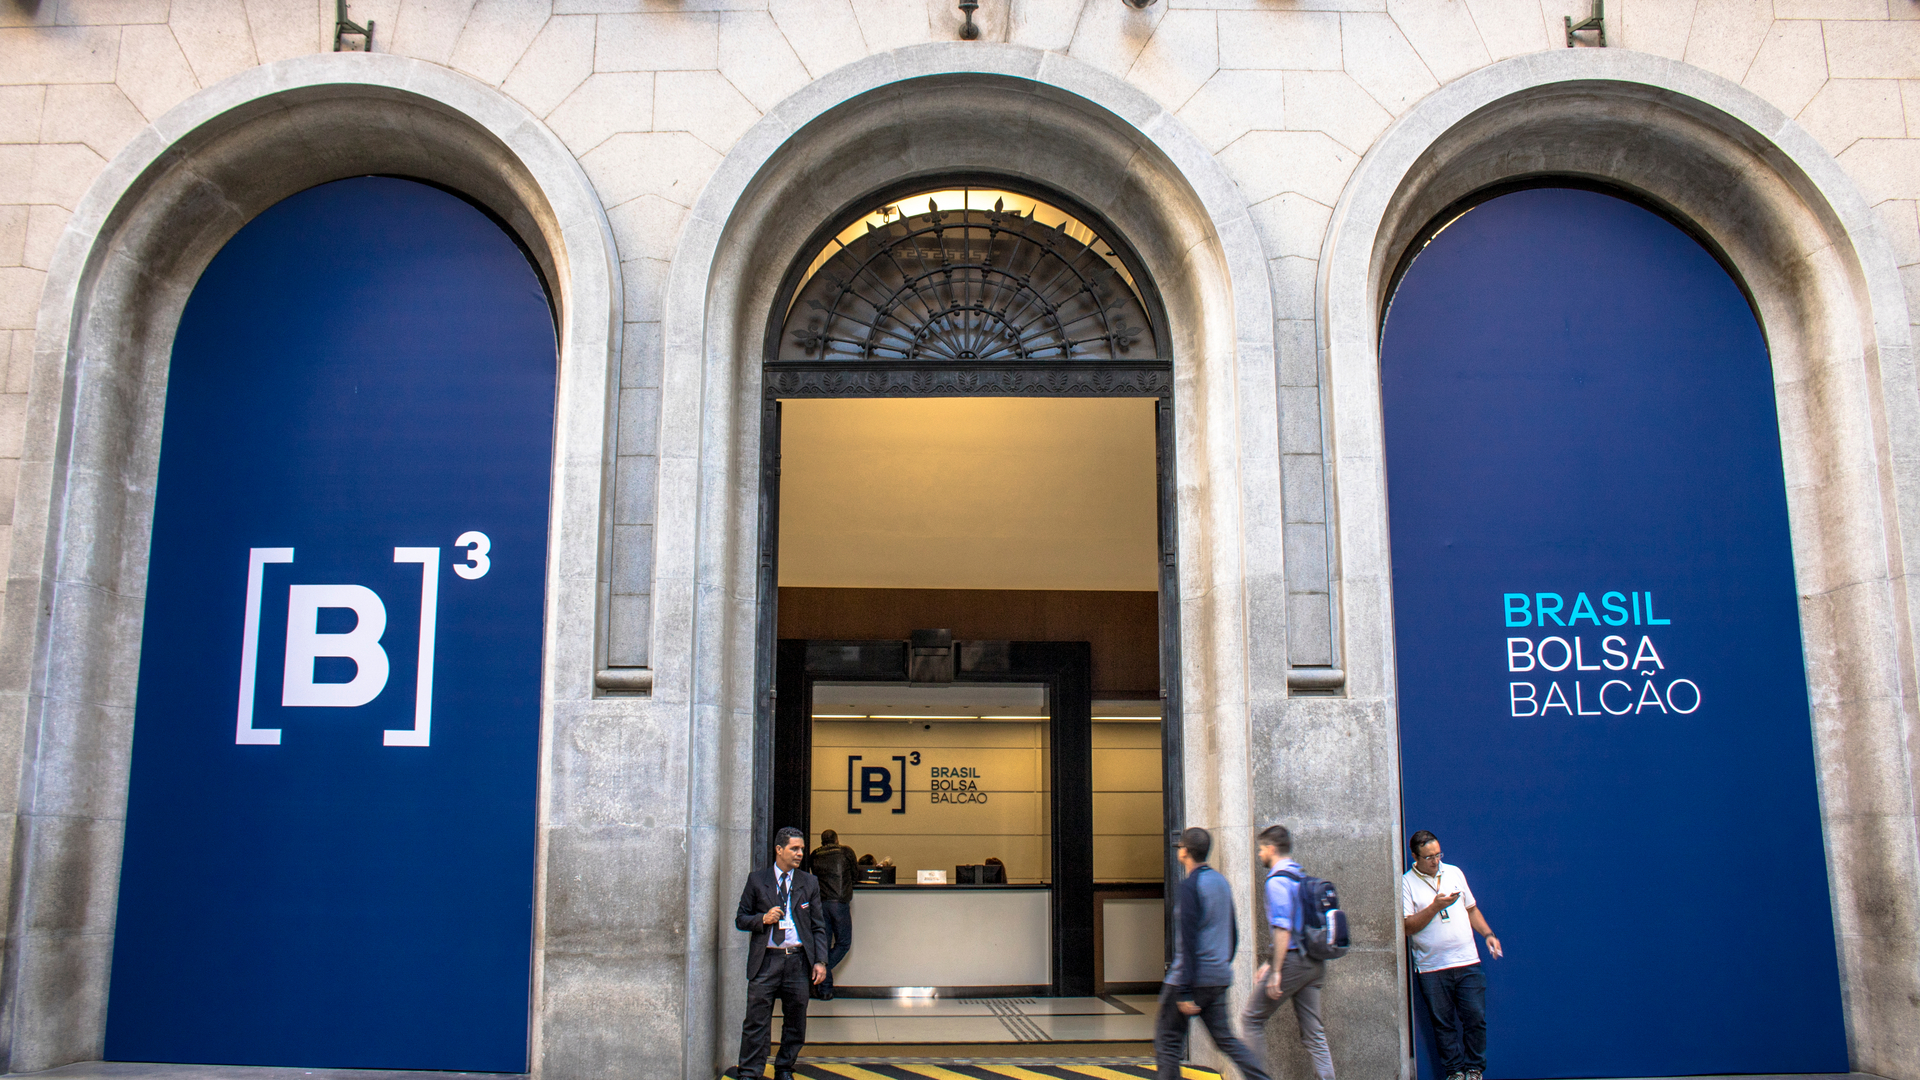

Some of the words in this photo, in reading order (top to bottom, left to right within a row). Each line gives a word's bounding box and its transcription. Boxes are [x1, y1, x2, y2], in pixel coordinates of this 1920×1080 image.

[1503, 591, 1671, 627] BRASIL
[1506, 635, 1665, 672] BOLSA
[1509, 669, 1701, 717] BALCÃO
[931, 767, 981, 778] BRASIL
[931, 780, 977, 791] BOLSA
[931, 790, 988, 804] BALCÃO
